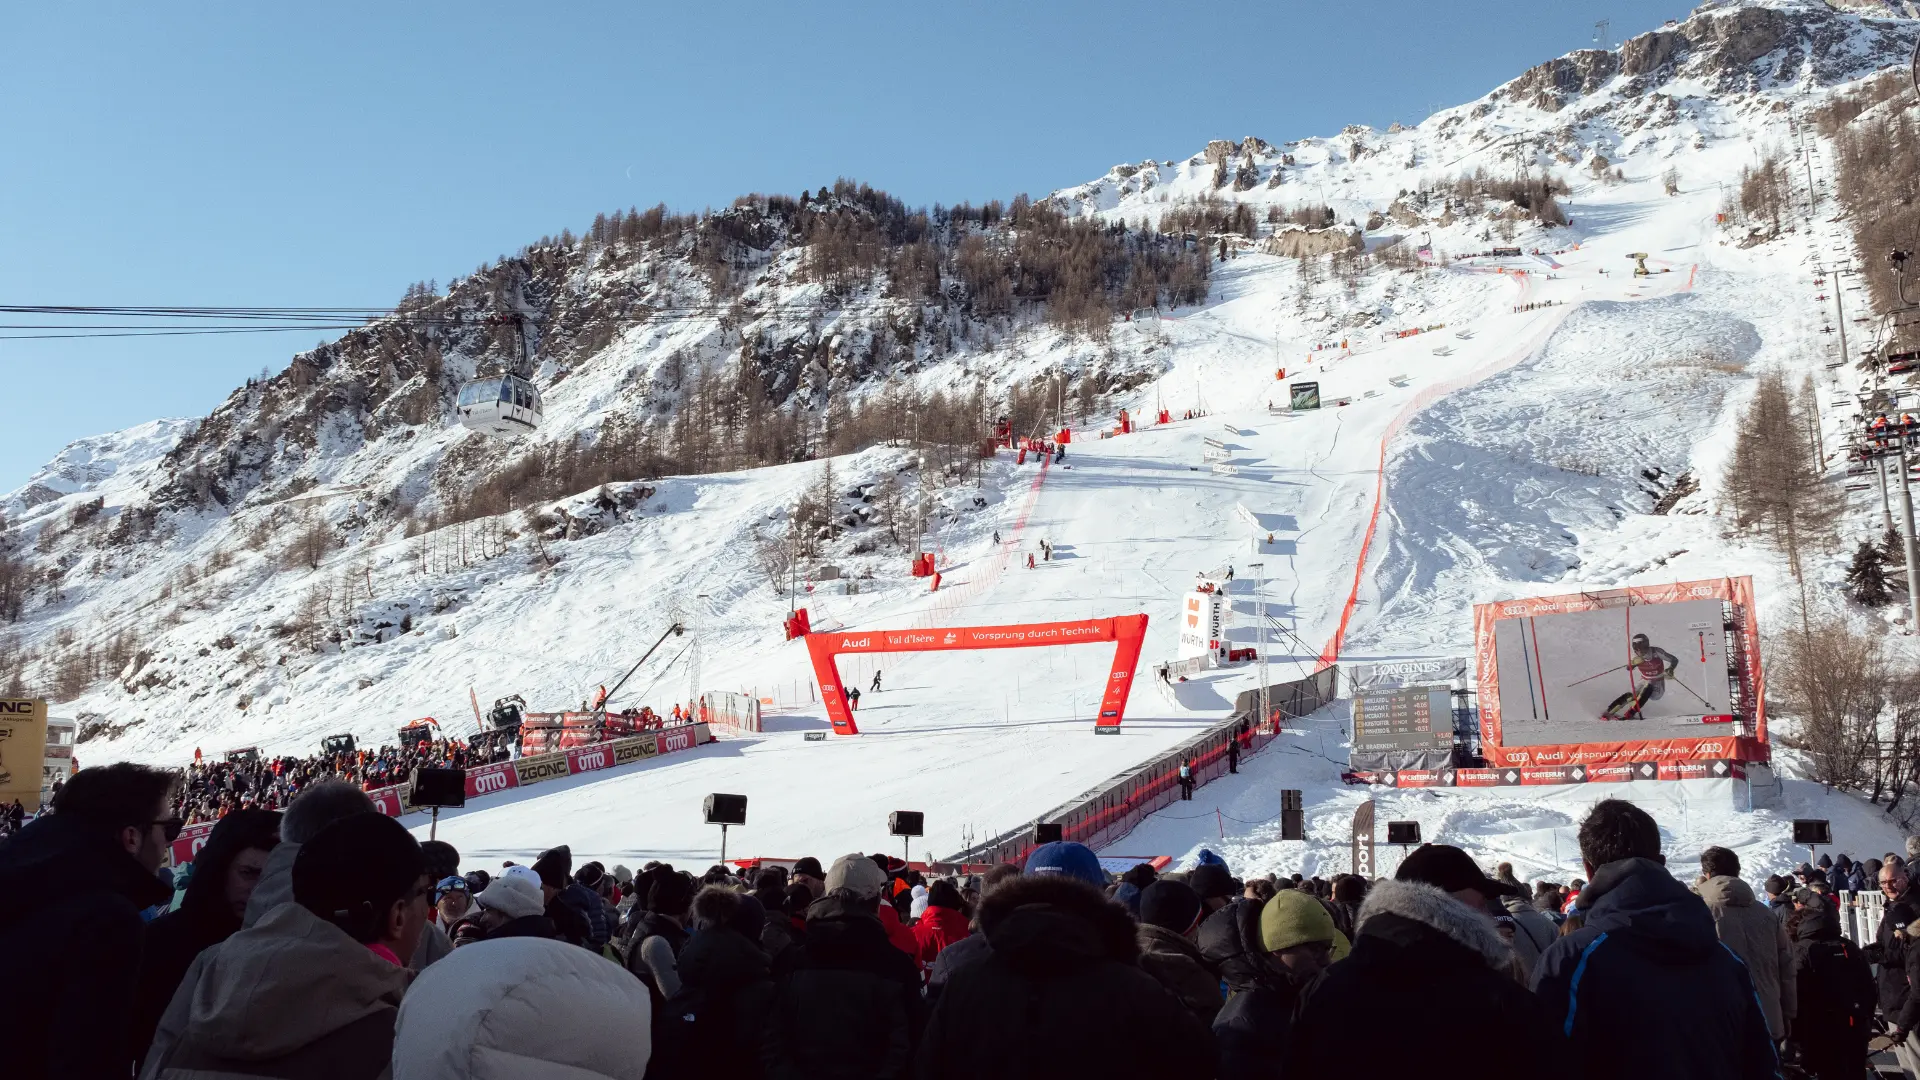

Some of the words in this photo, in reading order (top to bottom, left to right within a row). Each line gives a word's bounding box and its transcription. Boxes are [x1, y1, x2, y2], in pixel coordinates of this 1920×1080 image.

[1533, 602, 1559, 612] Audi
[1212, 602, 1220, 637] WÜRTH
[842, 637, 871, 649] Audi
[888, 634, 902, 645] Val
[904, 633, 935, 644] d'Isère
[972, 630, 1026, 641] Vorsprung
[1027, 629, 1059, 639] durch
[1061, 626, 1101, 637] Technik
[1372, 662, 1441, 675] LONGINES
[1482, 653, 1490, 682] World
[1485, 703, 1493, 720] FIS
[666, 734, 688, 751] OTTO
[1485, 723, 1494, 745] Audi
[615, 742, 655, 760] ZGONC
[1536, 750, 1564, 760] Audi
[1568, 751, 1618, 760] Vorsprung
[1620, 749, 1649, 757] durch
[1651, 746, 1690, 755] Technik
[578, 751, 605, 771] OTTO
[1669, 764, 1706, 773] CRITERIUM
[519, 762, 566, 781] ZGONC
[1531, 770, 1565, 778] CRITERIUM
[1598, 767, 1634, 775] CRITERIUM
[475, 771, 507, 793] OTTO
[1357, 833, 1372, 877] port
